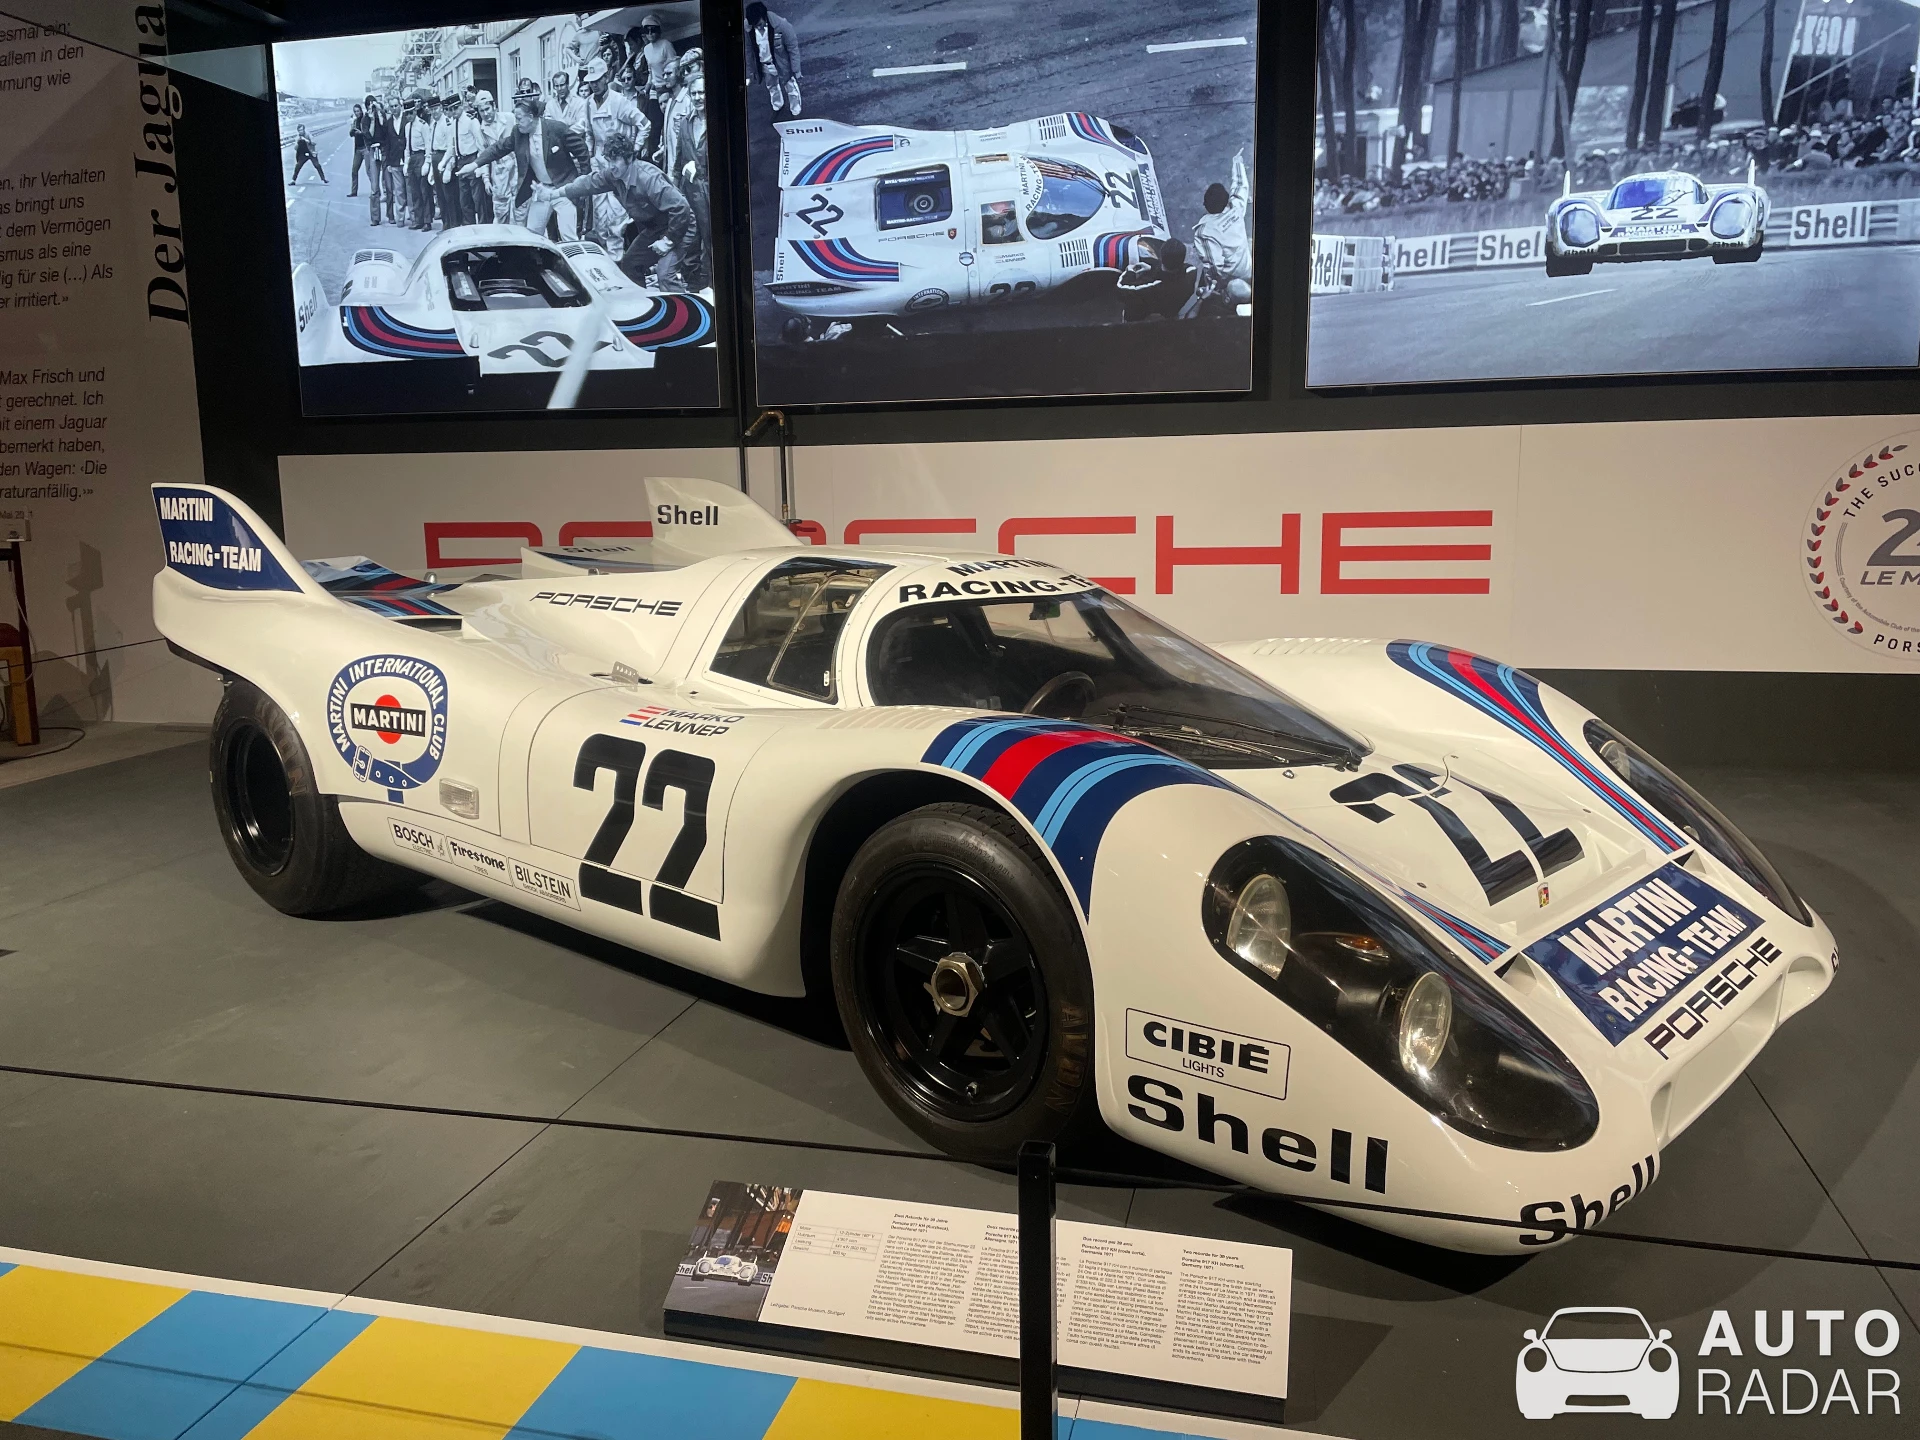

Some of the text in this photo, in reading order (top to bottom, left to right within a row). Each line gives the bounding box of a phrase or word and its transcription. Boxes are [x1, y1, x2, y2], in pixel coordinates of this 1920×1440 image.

[41, 49, 52, 62] in
[57, 45, 84, 60] den
[47, 70, 70, 85] wie
[785, 126, 824, 137] Shell
[782, 150, 792, 176] Shell
[19, 173, 38, 188] ihr
[41, 169, 106, 186] Verhalten
[1020, 162, 1030, 196] MARTINI
[1108, 171, 1139, 209] 22
[16, 197, 55, 215] bringt
[59, 196, 85, 208] uns
[796, 194, 844, 236] 22
[1631, 206, 1679, 220] 22
[6, 223, 36, 237] dem
[40, 217, 111, 236] Vermögen
[878, 229, 945, 243] PORSCHE
[1793, 206, 1868, 241] Shell
[38, 244, 58, 259] als
[62, 242, 91, 257] eine
[1395, 240, 1448, 269] hell
[1480, 230, 1543, 262] Shel
[17, 267, 37, 283] für
[39, 266, 59, 283] sie
[91, 264, 113, 280] Als
[147, 209, 191, 330] Der
[776, 252, 786, 281] Shell
[1312, 238, 1343, 287] hell
[299, 287, 318, 334] Shell
[0, 367, 105, 385] Max Frisch und
[6, 392, 78, 411] gerechnet.
[83, 390, 104, 406] Ich
[14, 416, 55, 431] einem
[59, 415, 108, 433] Jaguar
[58, 437, 105, 455] haben,
[25, 461, 76, 479] Wagen:
[1843, 462, 1920, 518] THE SUC
[158, 496, 214, 522] MARTINI
[657, 504, 719, 526] Shell
[169, 541, 262, 572] RACING-TEAM
[562, 545, 635, 554] Shell
[1860, 571, 1897, 586] LE
[529, 591, 684, 617] PORSCHE
[1862, 608, 1890, 627] Automobile
[1890, 622, 1903, 631] Club
[330, 677, 350, 753] MARTINI
[349, 657, 445, 710] INTERNATIONAL
[429, 713, 445, 761] CLUB
[353, 707, 423, 733] MARTINI
[660, 709, 745, 723] MARKO
[642, 717, 730, 737] LENNEP
[393, 823, 434, 850] BOSCH
[573, 733, 722, 941] 22
[1329, 763, 1586, 907] 22
[450, 840, 505, 871] Firestone
[514, 864, 571, 899] BILSTEIN
[1557, 876, 1698, 976] MARTINI
[1597, 904, 1748, 1022] RACING-TEAM
[1644, 936, 1783, 1060] PORSCHE
[1182, 1057, 1225, 1078] LIGHTS
[1127, 1074, 1389, 1195] Shell
[1519, 1154, 1655, 1245] Shell
